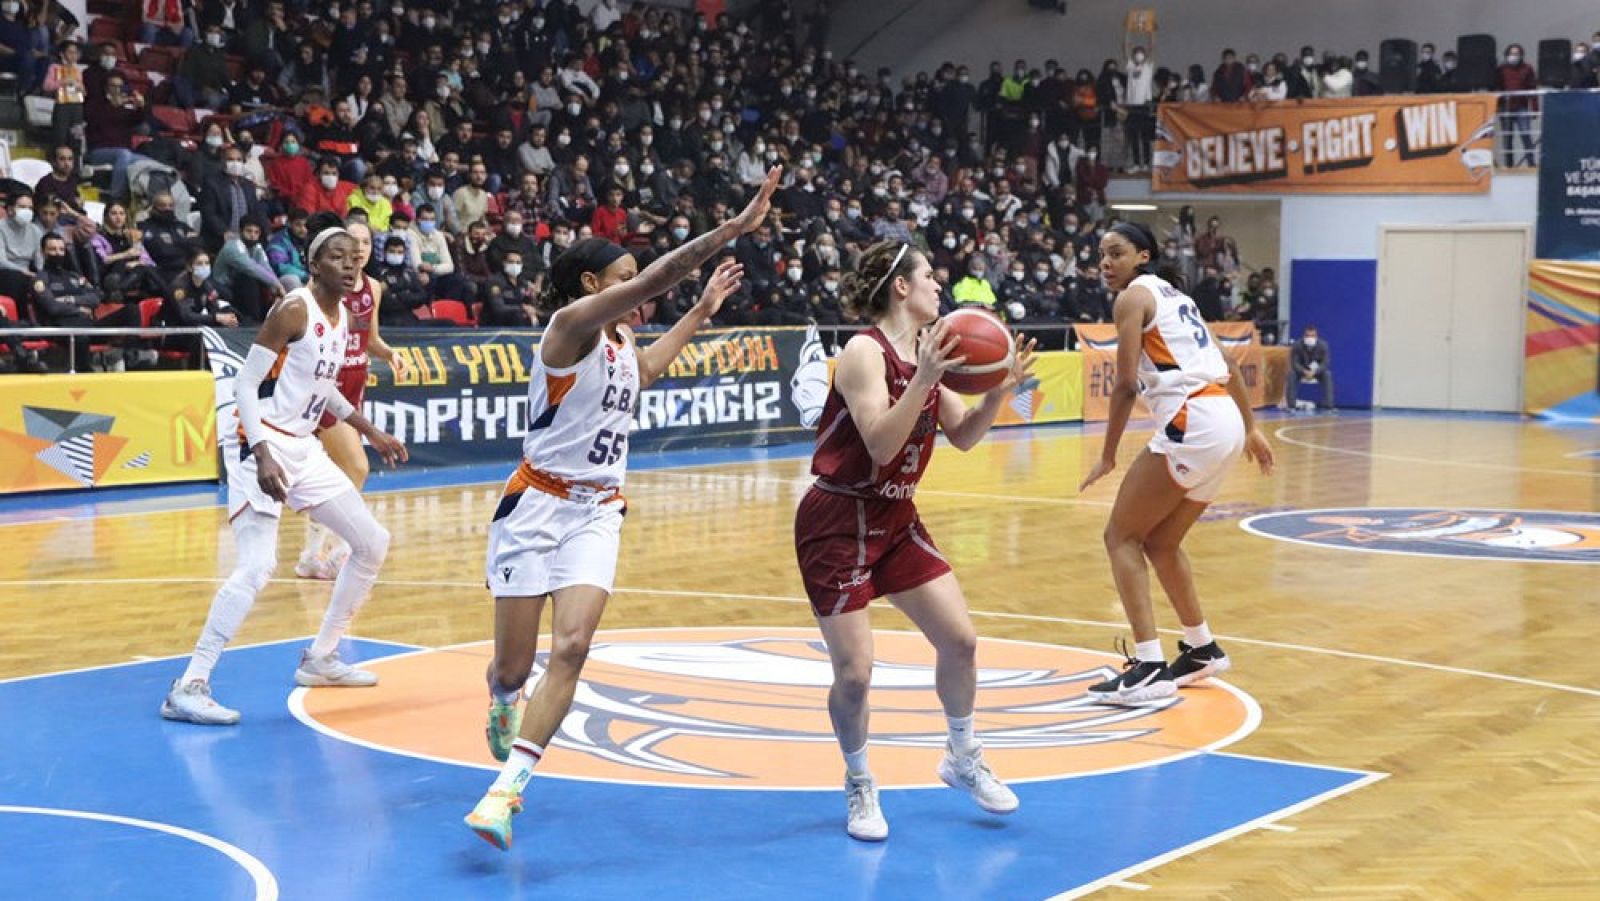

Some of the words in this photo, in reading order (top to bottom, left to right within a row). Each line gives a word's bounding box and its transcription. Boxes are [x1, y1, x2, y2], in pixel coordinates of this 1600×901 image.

[1186, 127, 1286, 179] BELIEVE
[1302, 113, 1376, 165] FIGHT
[1401, 100, 1458, 151] WIN
[452, 343, 539, 384] YOL
[301, 394, 327, 422] 14
[362, 389, 529, 444] MPİYO
[629, 377, 782, 430] ACAĞIZ
[587, 428, 626, 467] 55
